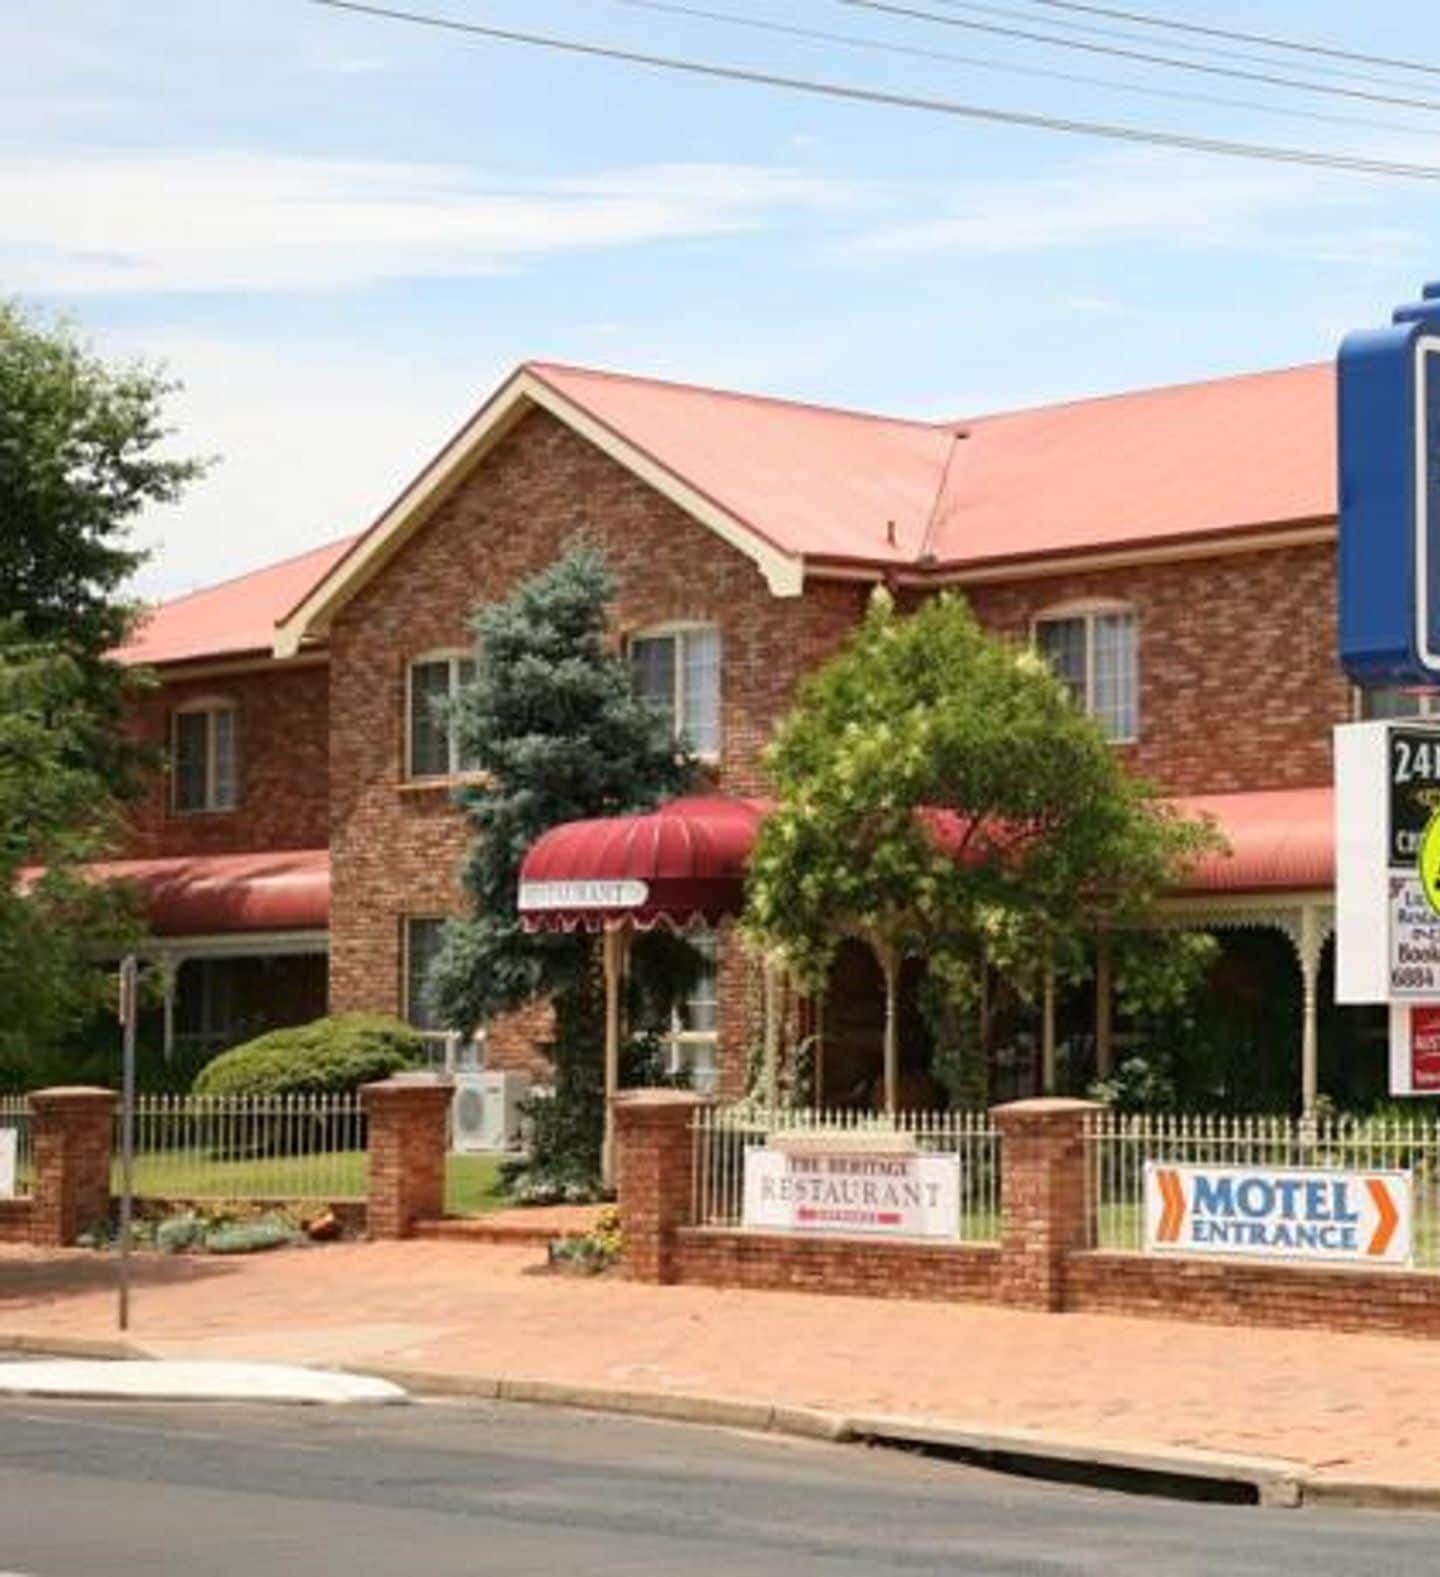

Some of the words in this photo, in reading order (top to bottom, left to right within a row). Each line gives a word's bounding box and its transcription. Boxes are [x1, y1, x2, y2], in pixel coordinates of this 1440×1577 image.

[789, 1157, 819, 1174] THE
[828, 1158, 909, 1177] HERITAGE
[761, 1175, 942, 1207] RESTAURANT
[1191, 1175, 1358, 1222] MOTEL
[1191, 1219, 1358, 1250] ENTRANCE
